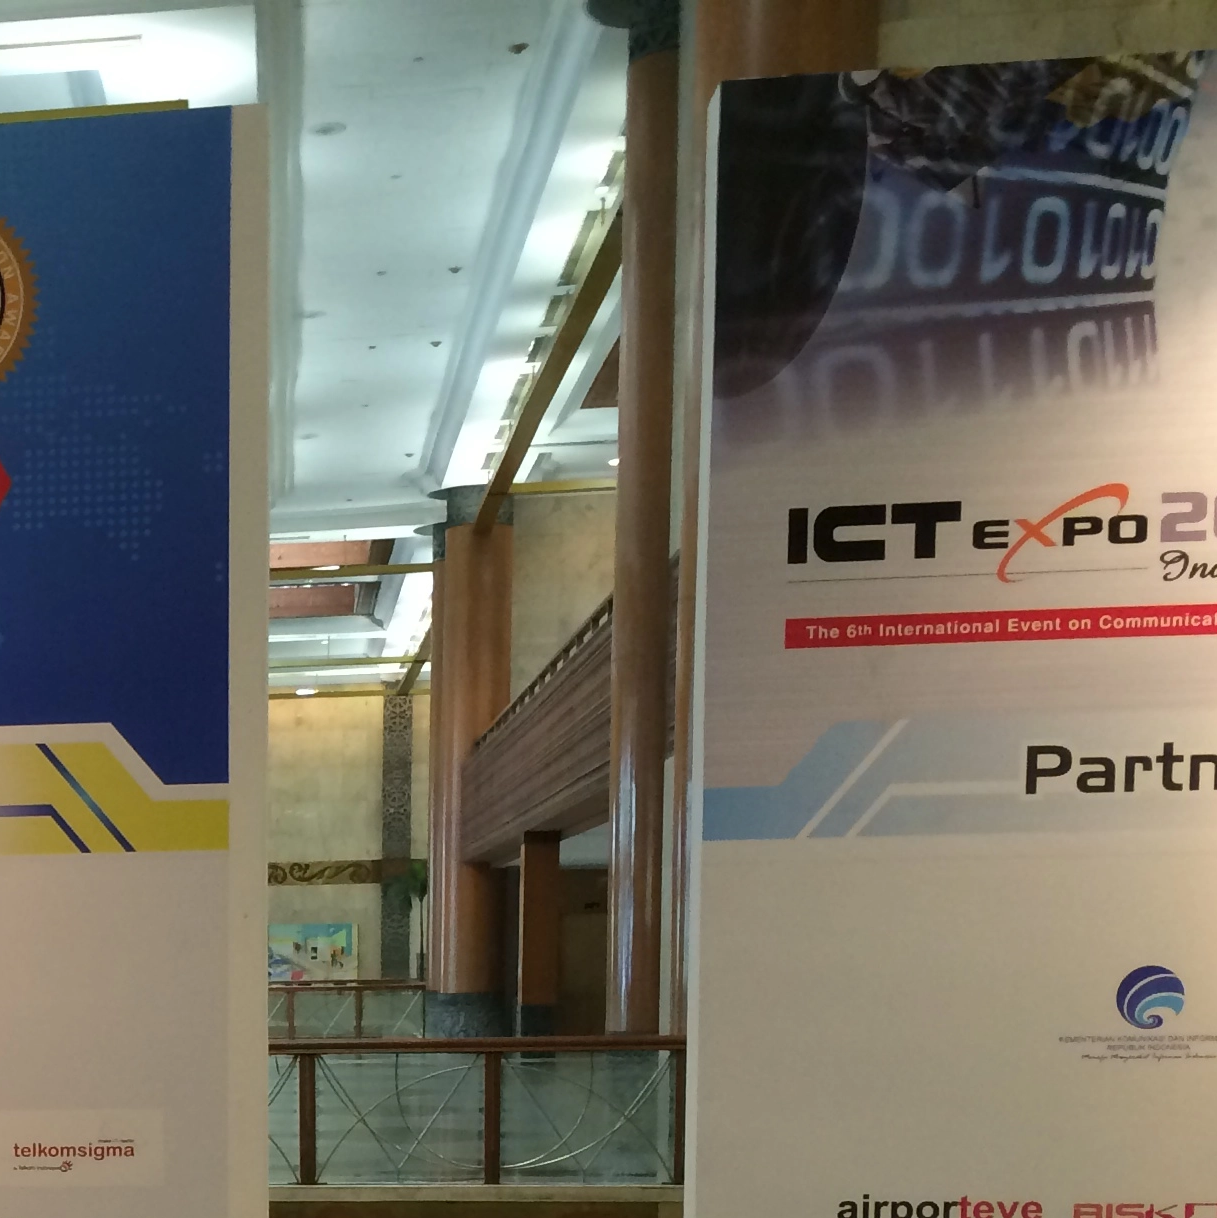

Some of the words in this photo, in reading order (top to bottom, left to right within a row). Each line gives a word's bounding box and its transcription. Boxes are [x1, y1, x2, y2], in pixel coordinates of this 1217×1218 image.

[787, 500, 963, 564] ICT
[805, 624, 840, 640] The
[846, 623, 873, 639] 6th
[879, 618, 1000, 638] International
[1008, 615, 1062, 633] Event
[1068, 618, 1092, 631] on
[13, 1142, 135, 1161] telkomsigma
